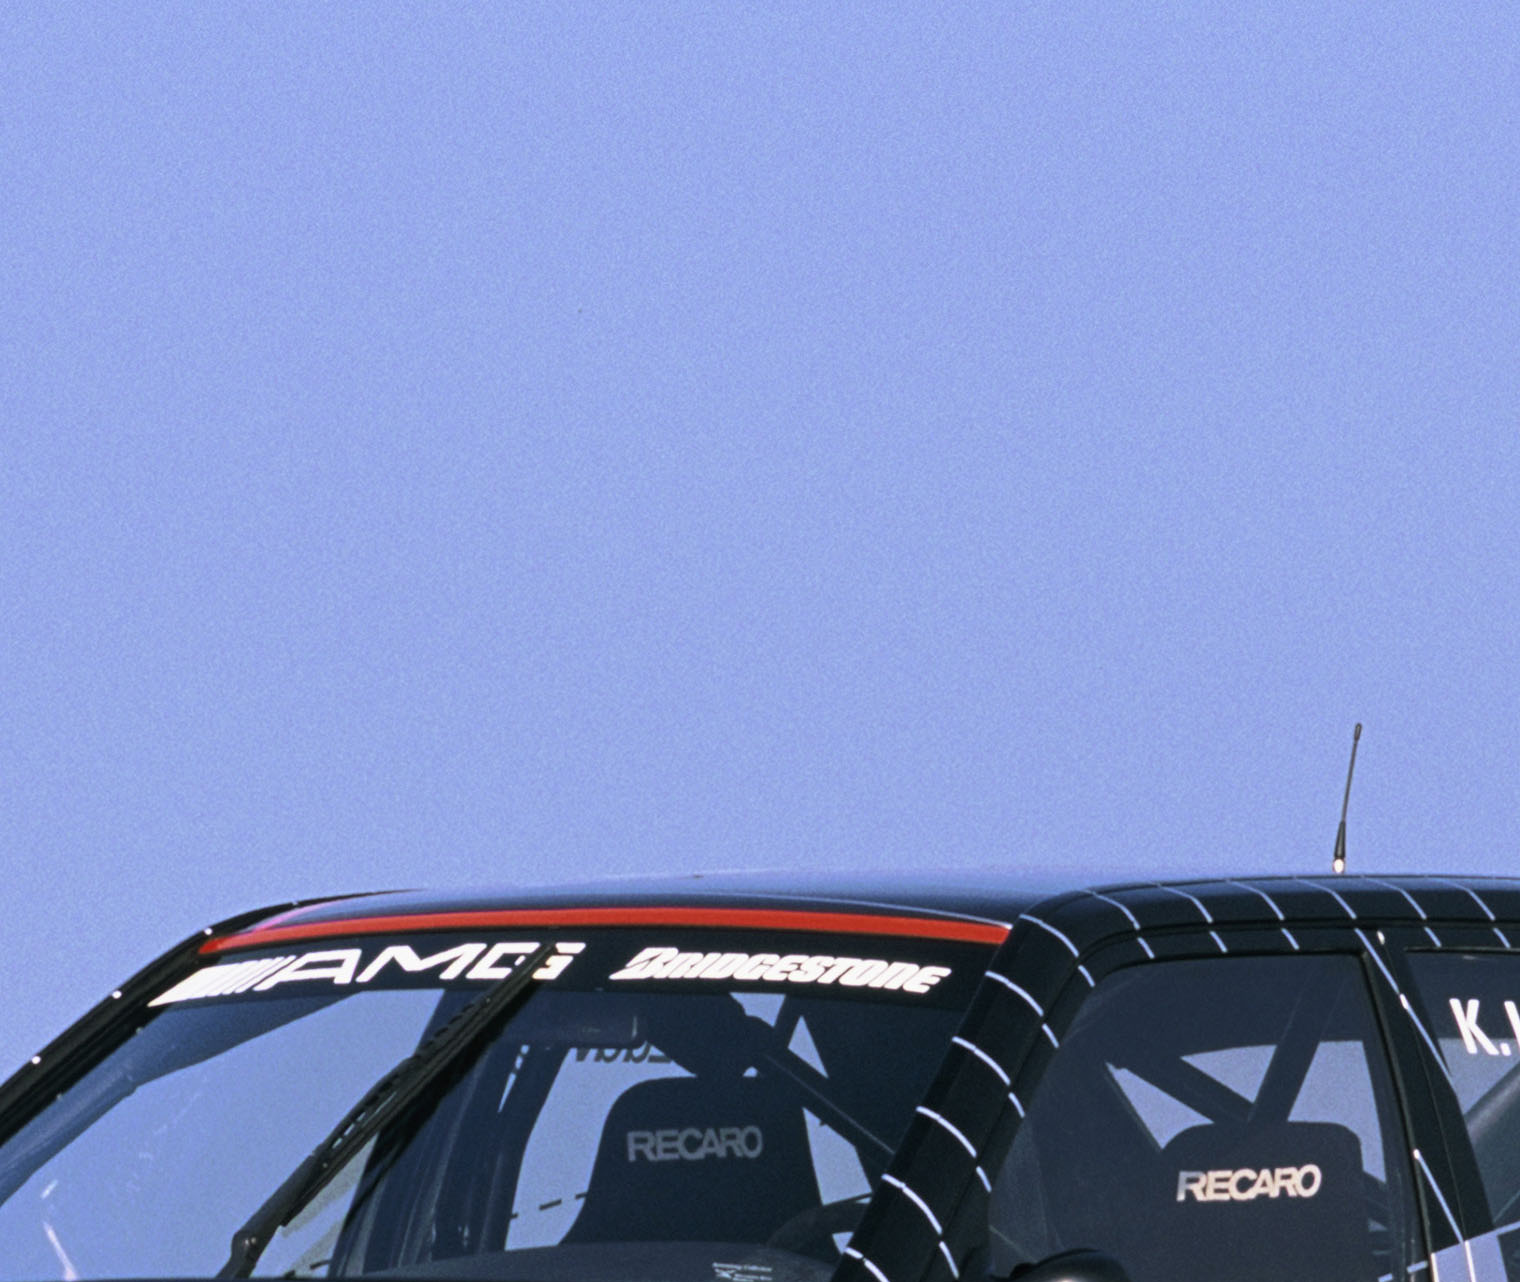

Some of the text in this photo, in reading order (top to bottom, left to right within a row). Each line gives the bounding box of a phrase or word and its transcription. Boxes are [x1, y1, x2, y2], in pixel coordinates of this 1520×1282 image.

[263, 941, 585, 990] AMG
[609, 946, 953, 994] BRIDGESTONE
[627, 1125, 764, 1163] RECARO
[1176, 1163, 1323, 1203] RECARO
